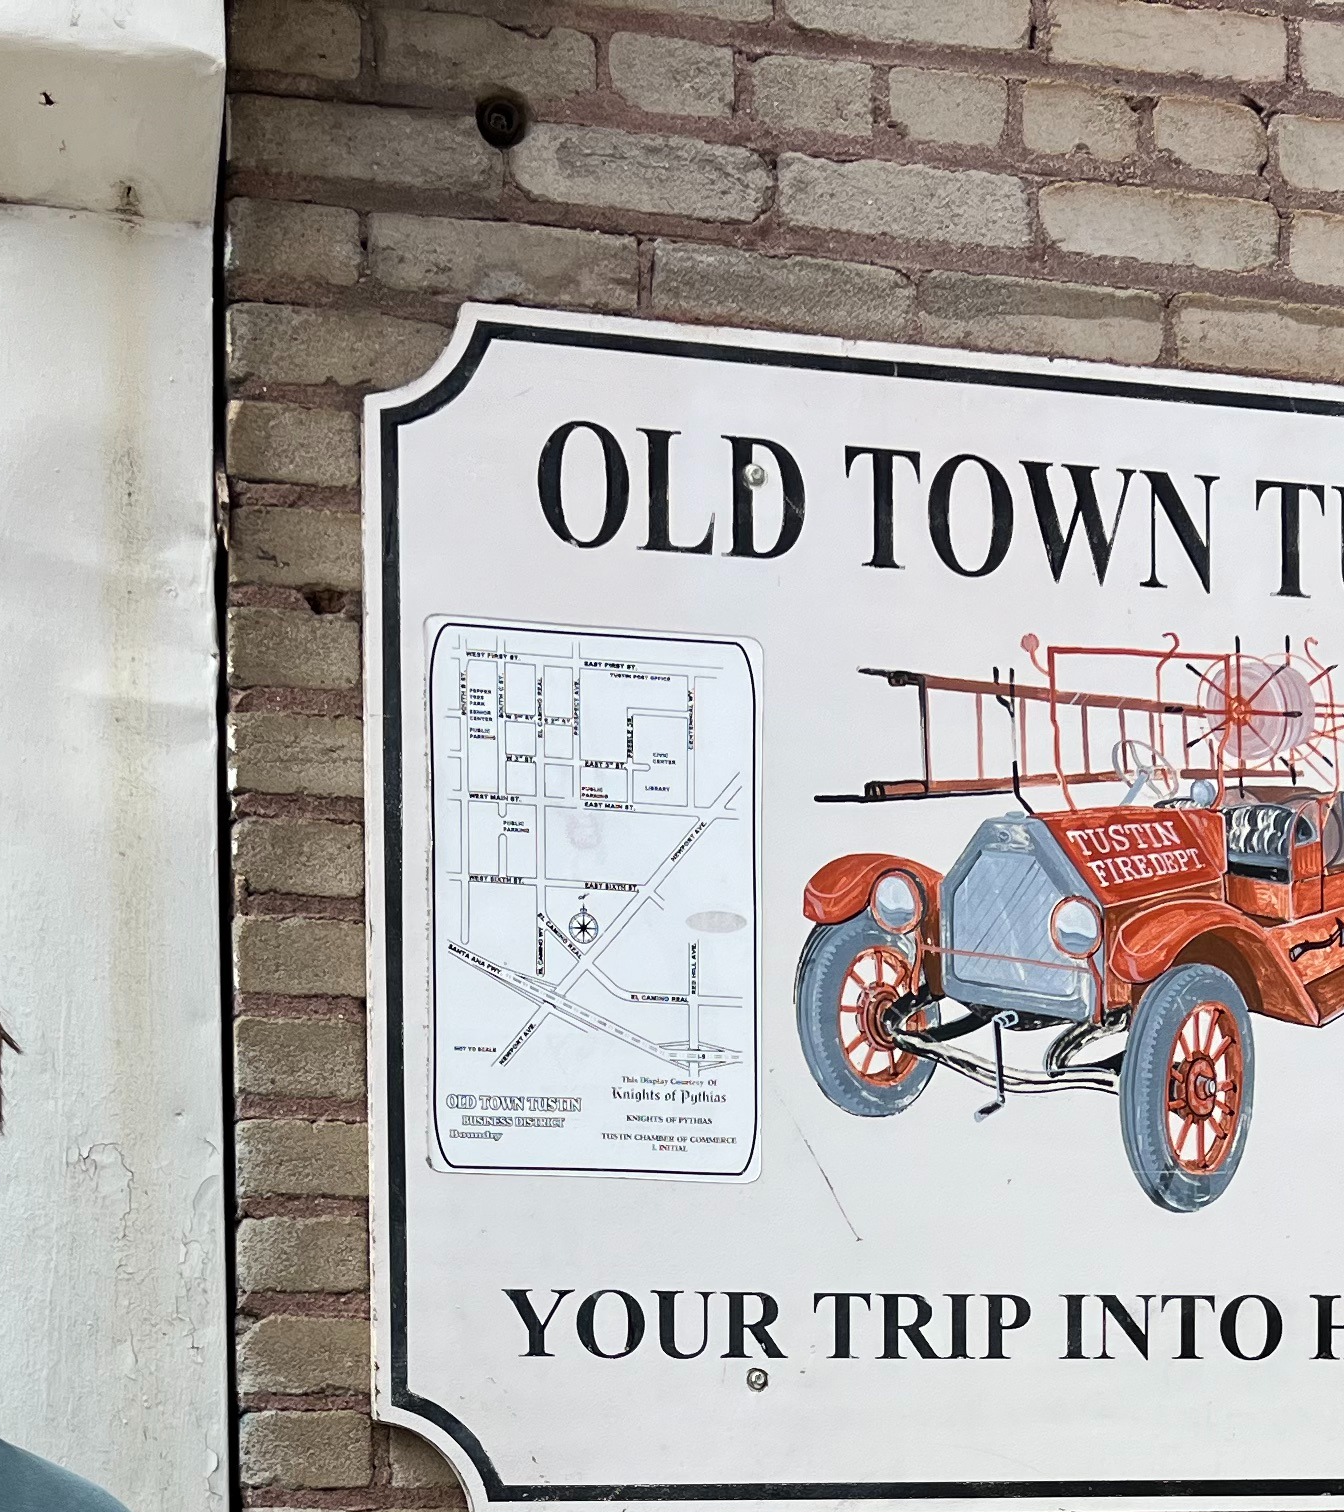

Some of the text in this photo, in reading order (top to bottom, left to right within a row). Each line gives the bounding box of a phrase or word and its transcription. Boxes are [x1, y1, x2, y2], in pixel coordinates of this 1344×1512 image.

[537, 420, 806, 560] OLD
[844, 445, 1222, 595] TOWN
[1065, 820, 1182, 857] TUSTIN
[446, 1094, 582, 1112] OLD TOWN TUSTIN
[611, 1086, 727, 1105] Knights of Pythias
[462, 1115, 565, 1128] BUSINESS DISTRICT
[626, 1114, 664, 1123] KNIGHTS
[678, 1117, 713, 1125] PYTHIAS
[601, 1132, 632, 1140] TUSTIN
[634, 1134, 674, 1142] CHAMBER
[690, 1136, 737, 1144] COMMERCE
[501, 1288, 789, 1360] YOUR
[813, 1292, 1031, 1360] TRIP
[1059, 1294, 1283, 1361] INTO
